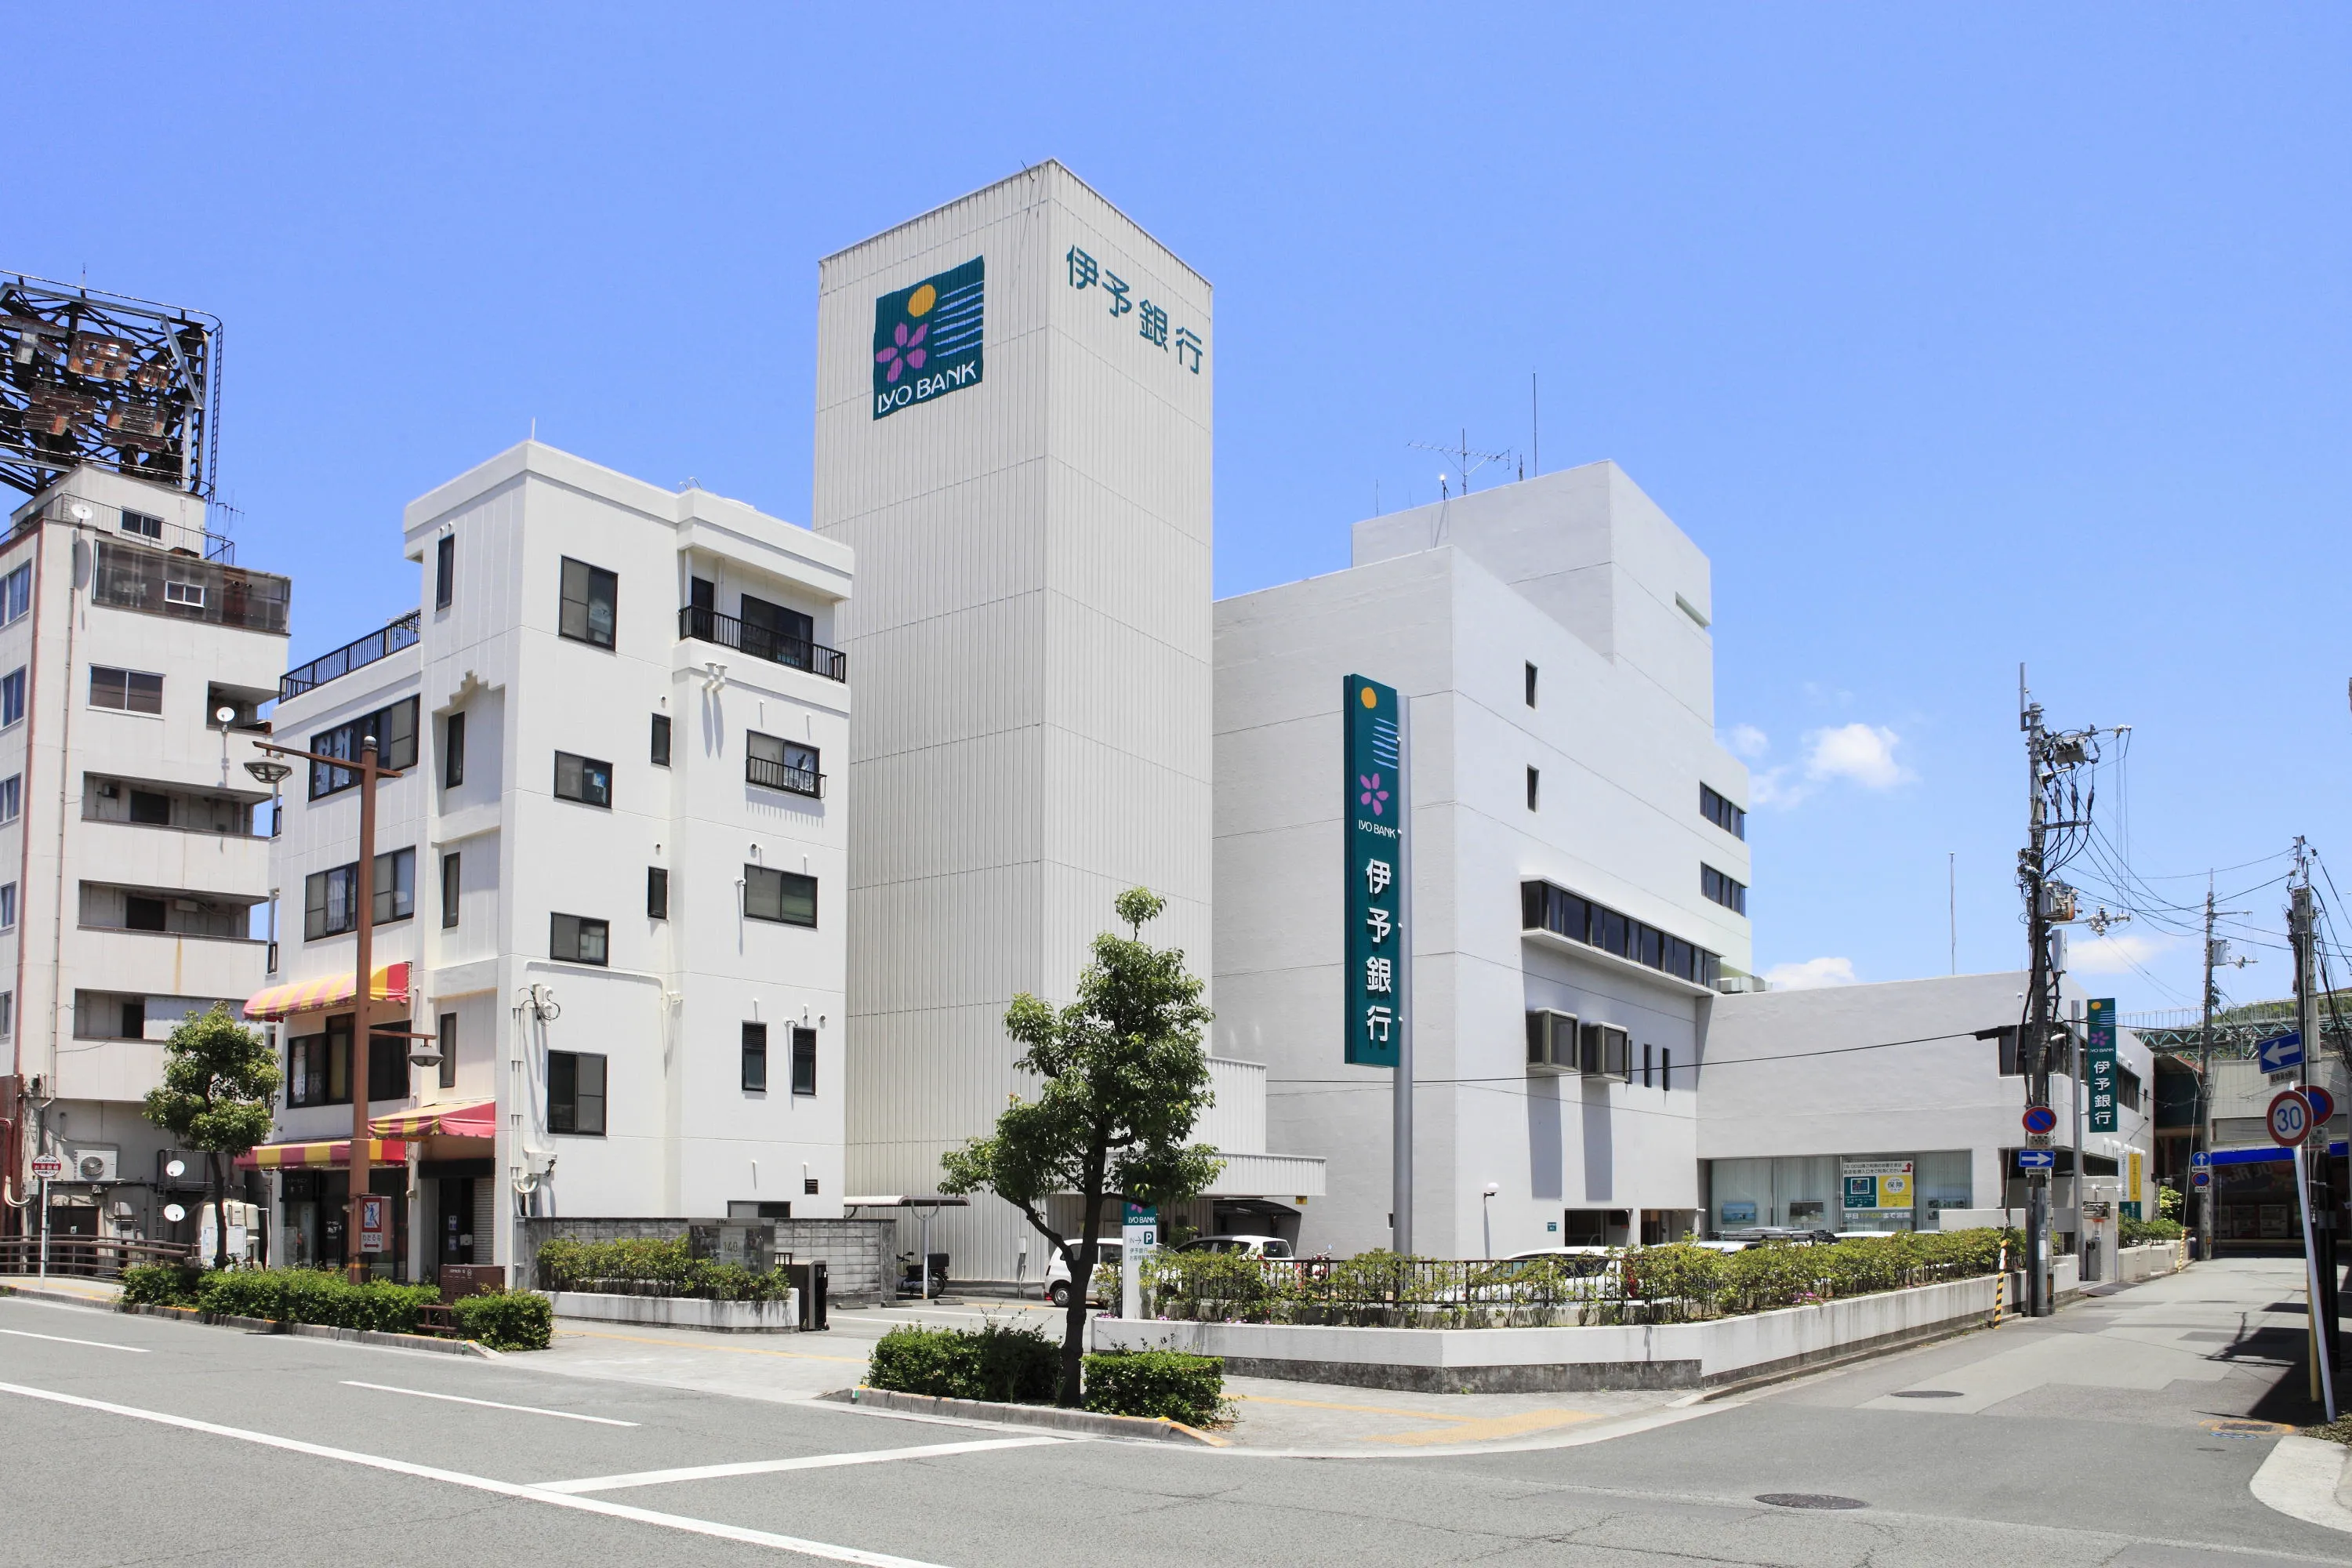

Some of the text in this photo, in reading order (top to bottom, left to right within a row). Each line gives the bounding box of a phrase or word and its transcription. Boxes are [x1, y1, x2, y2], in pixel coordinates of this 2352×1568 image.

[1066, 245, 1203, 375] 伊予銀行
[877, 360, 977, 415] IYO BANK
[1358, 819, 1396, 839] IYO BANK
[1366, 858, 1392, 1042] 伊予銀行
[2094, 1061, 2111, 1125] 伊予銀行
[2277, 1105, 2303, 1132] 30
[1145, 1233, 1152, 1243] P
